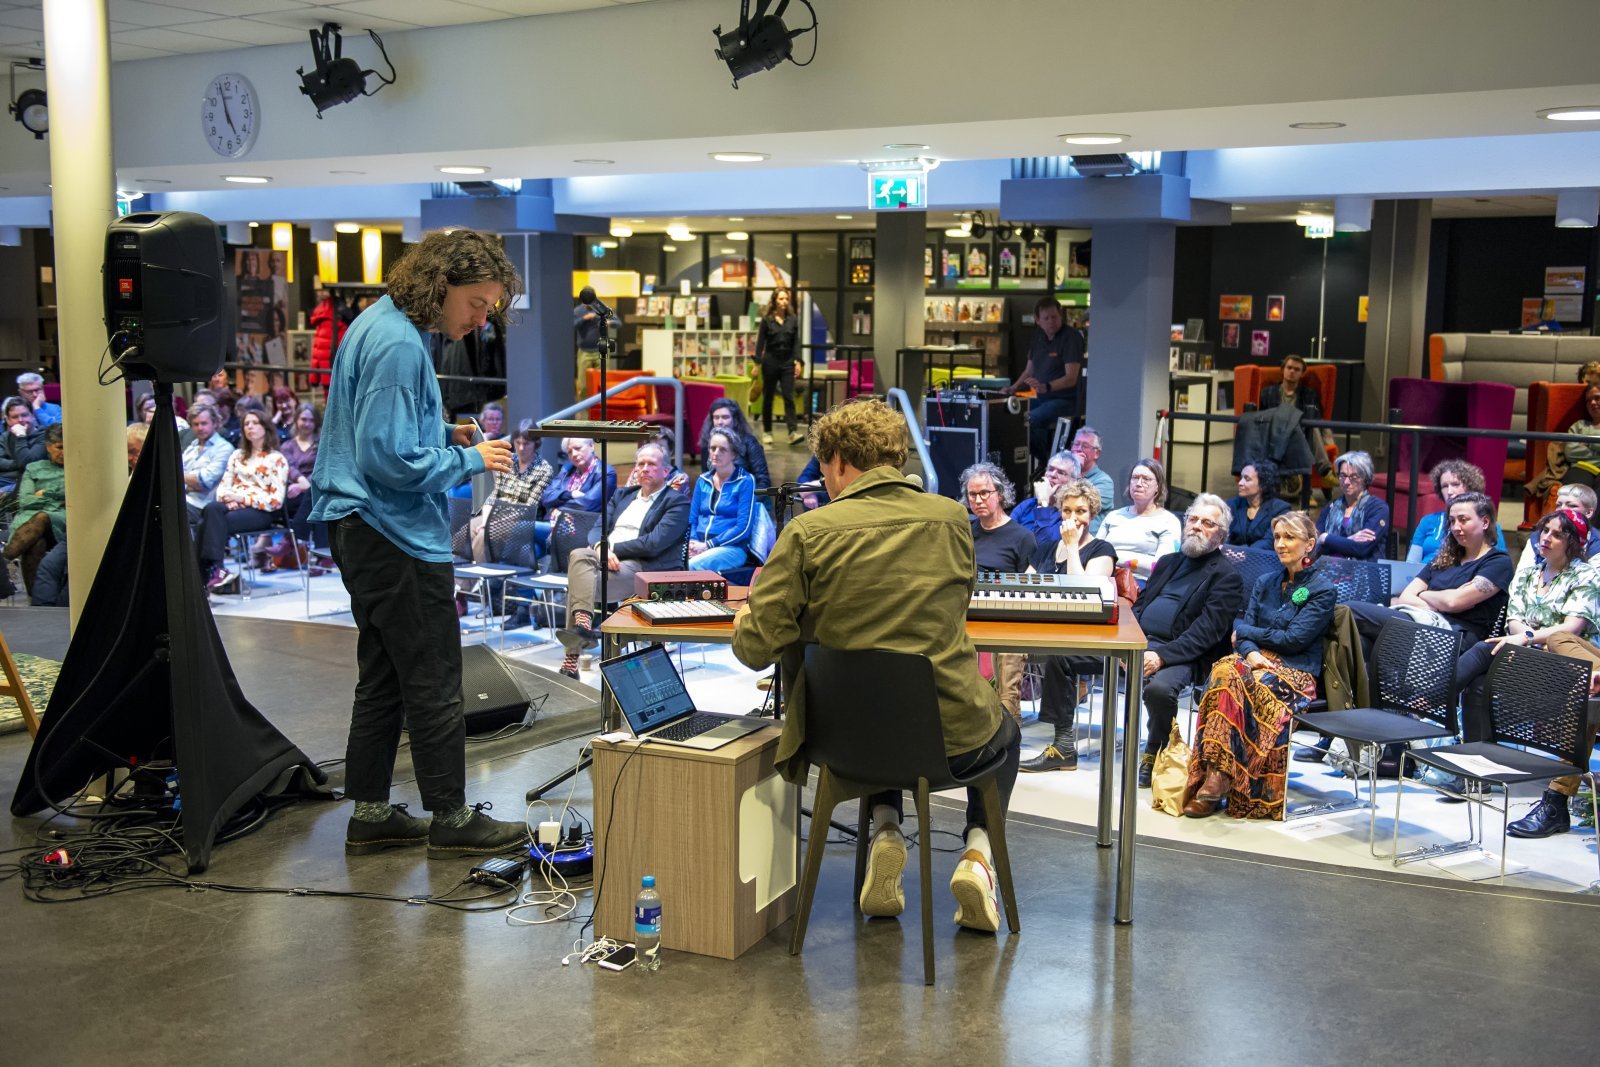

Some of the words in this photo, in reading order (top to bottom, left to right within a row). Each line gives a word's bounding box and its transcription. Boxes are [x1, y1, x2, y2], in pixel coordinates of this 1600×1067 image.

[224, 81, 231, 91] 12
[207, 97, 217, 107] 10
[241, 94, 247, 105] 2
[208, 112, 214, 122] 9
[244, 108, 249, 119] 3
[211, 126, 216, 136] 8
[242, 124, 247, 133] 4
[218, 136, 223, 146] 7
[236, 134, 241, 144] 5
[227, 140, 232, 150] 6
